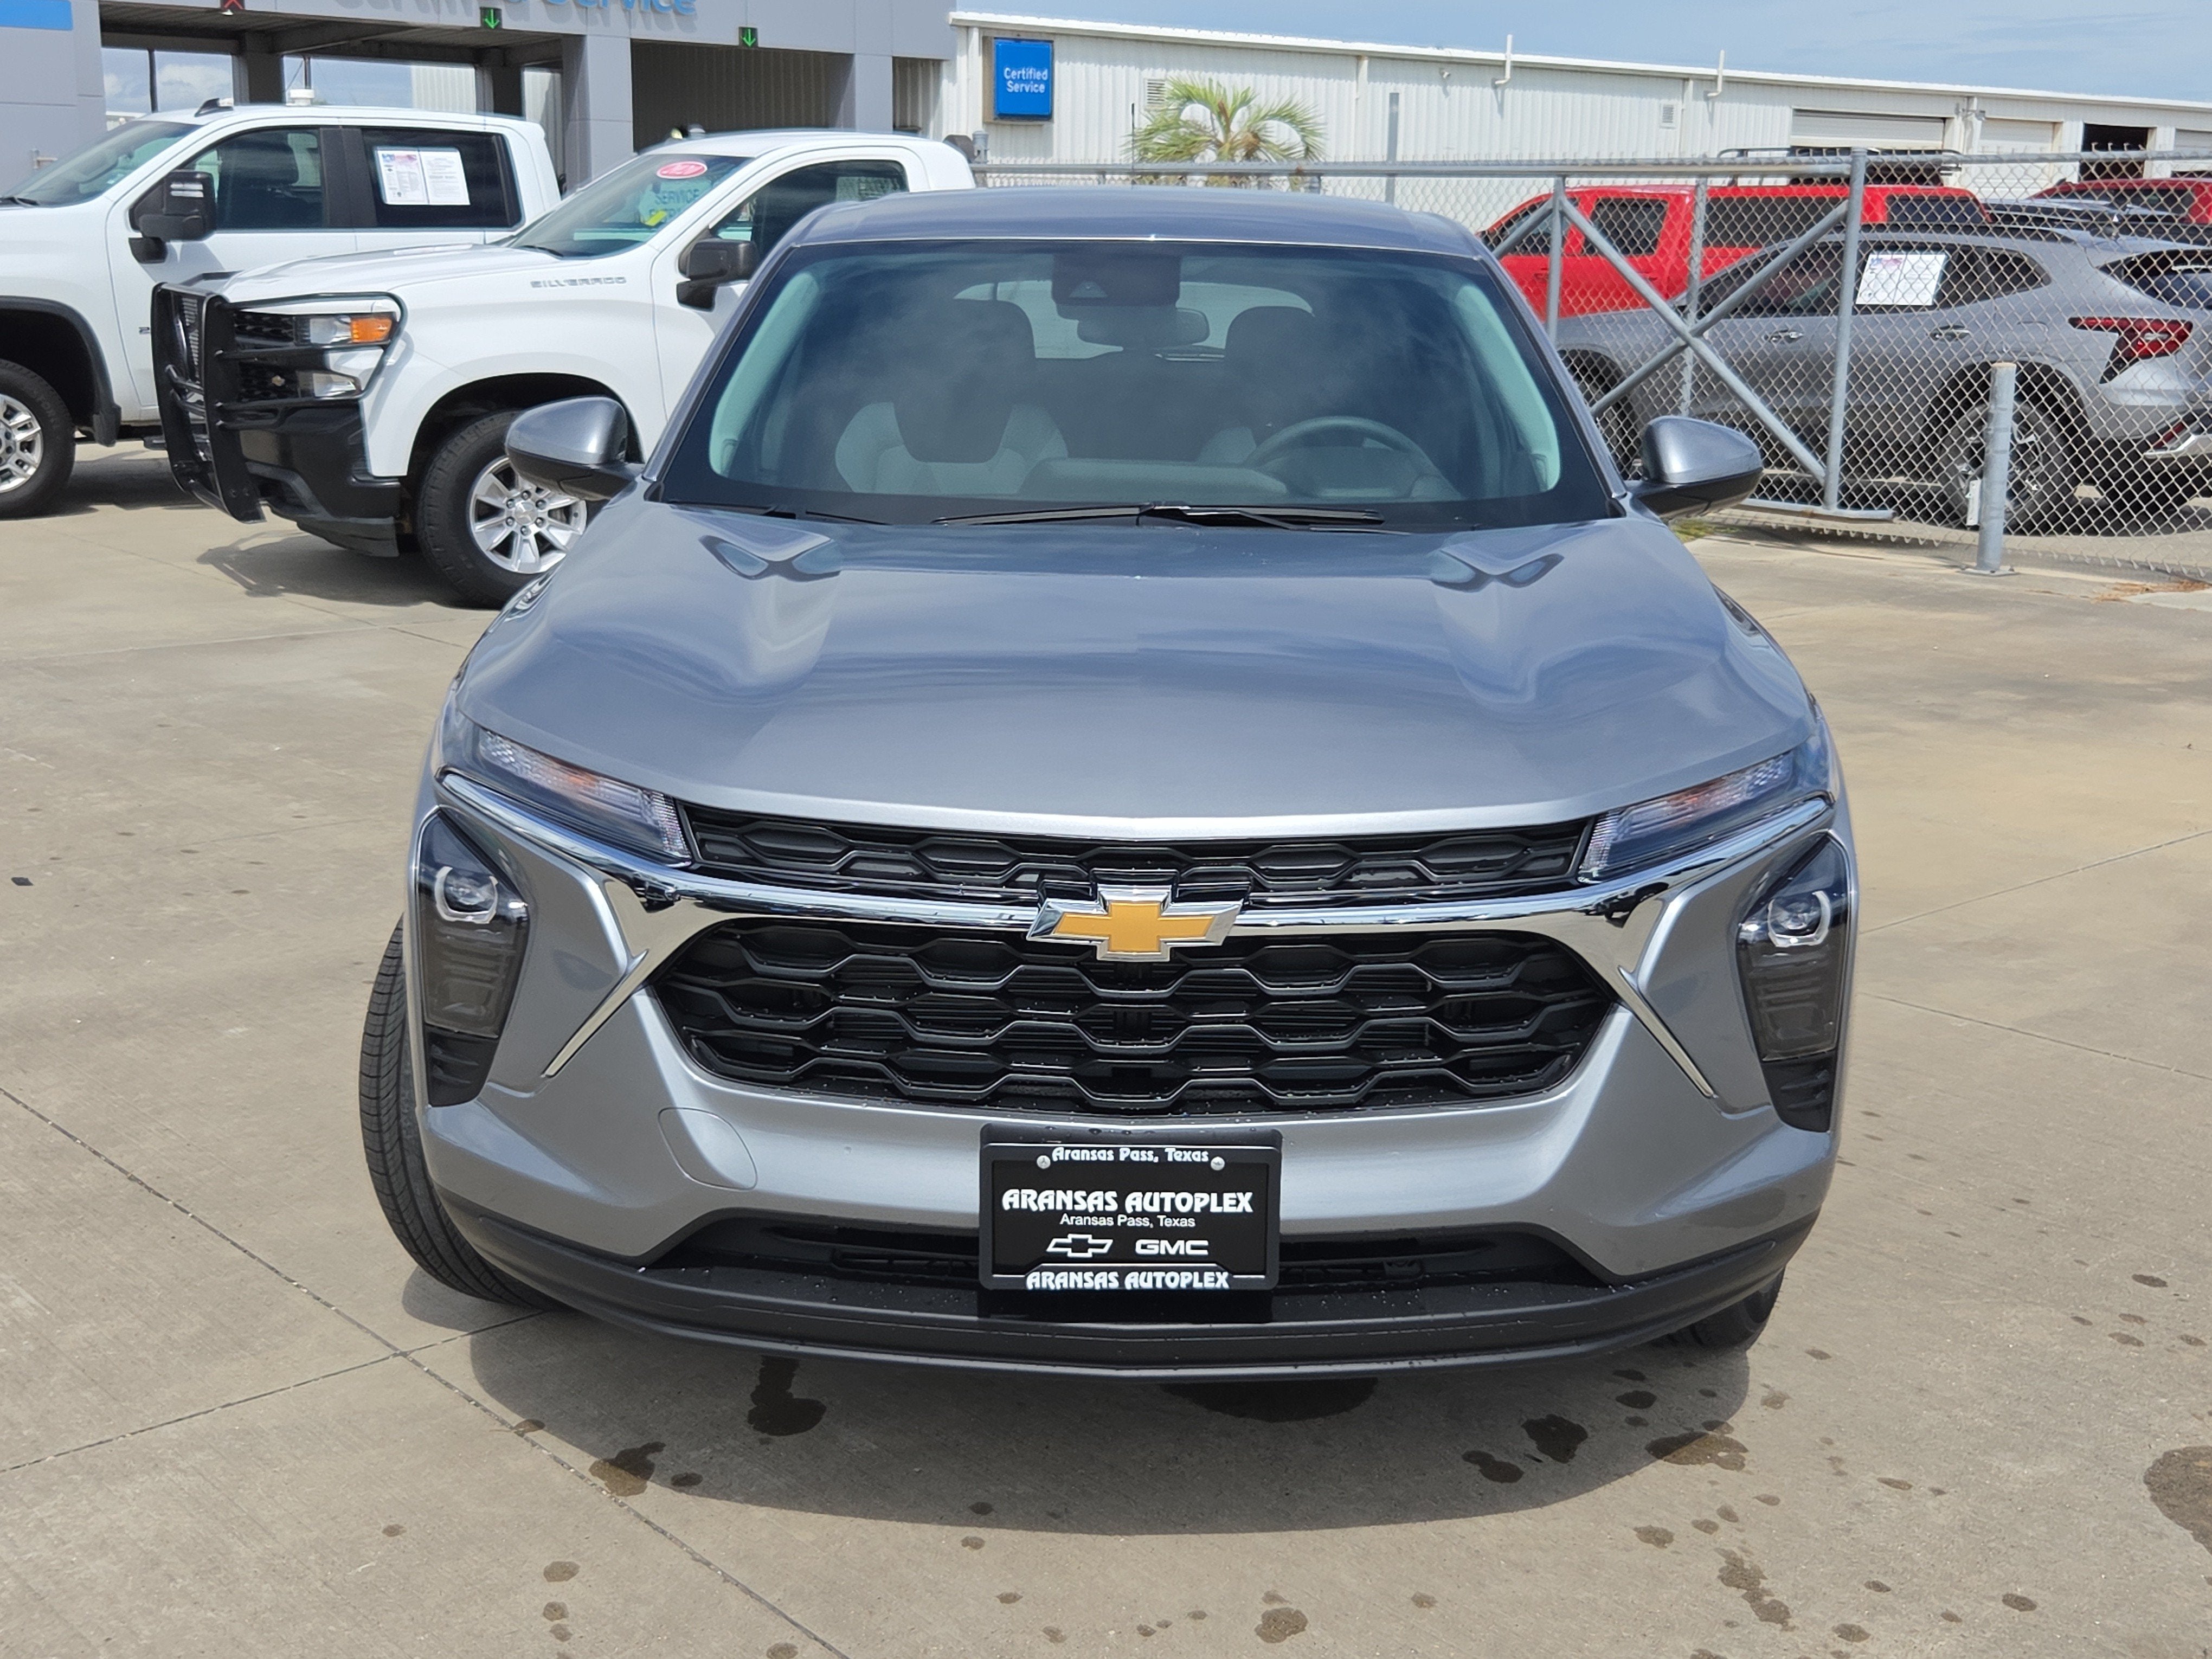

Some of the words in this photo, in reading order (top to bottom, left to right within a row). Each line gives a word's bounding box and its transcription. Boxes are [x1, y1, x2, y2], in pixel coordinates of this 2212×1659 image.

[1004, 67, 1048, 81] Certified
[1006, 80, 1045, 93] Service
[530, 277, 627, 288] SILVERADO
[1052, 1147, 1114, 1161] Aransas
[1119, 1148, 1159, 1162] Pass,
[1165, 1148, 1208, 1162] Texas
[1002, 1189, 1117, 1212] ARANSAS
[1125, 1192, 1253, 1212] AUTOPLEX
[1060, 1213, 1114, 1226] Aransas
[1117, 1214, 1154, 1228] Pass,
[1157, 1216, 1195, 1227] Texas
[1135, 1239, 1208, 1255] GMC
[1026, 1271, 1119, 1290] ARANSAS
[1124, 1271, 1229, 1290] AUTOPLEX
